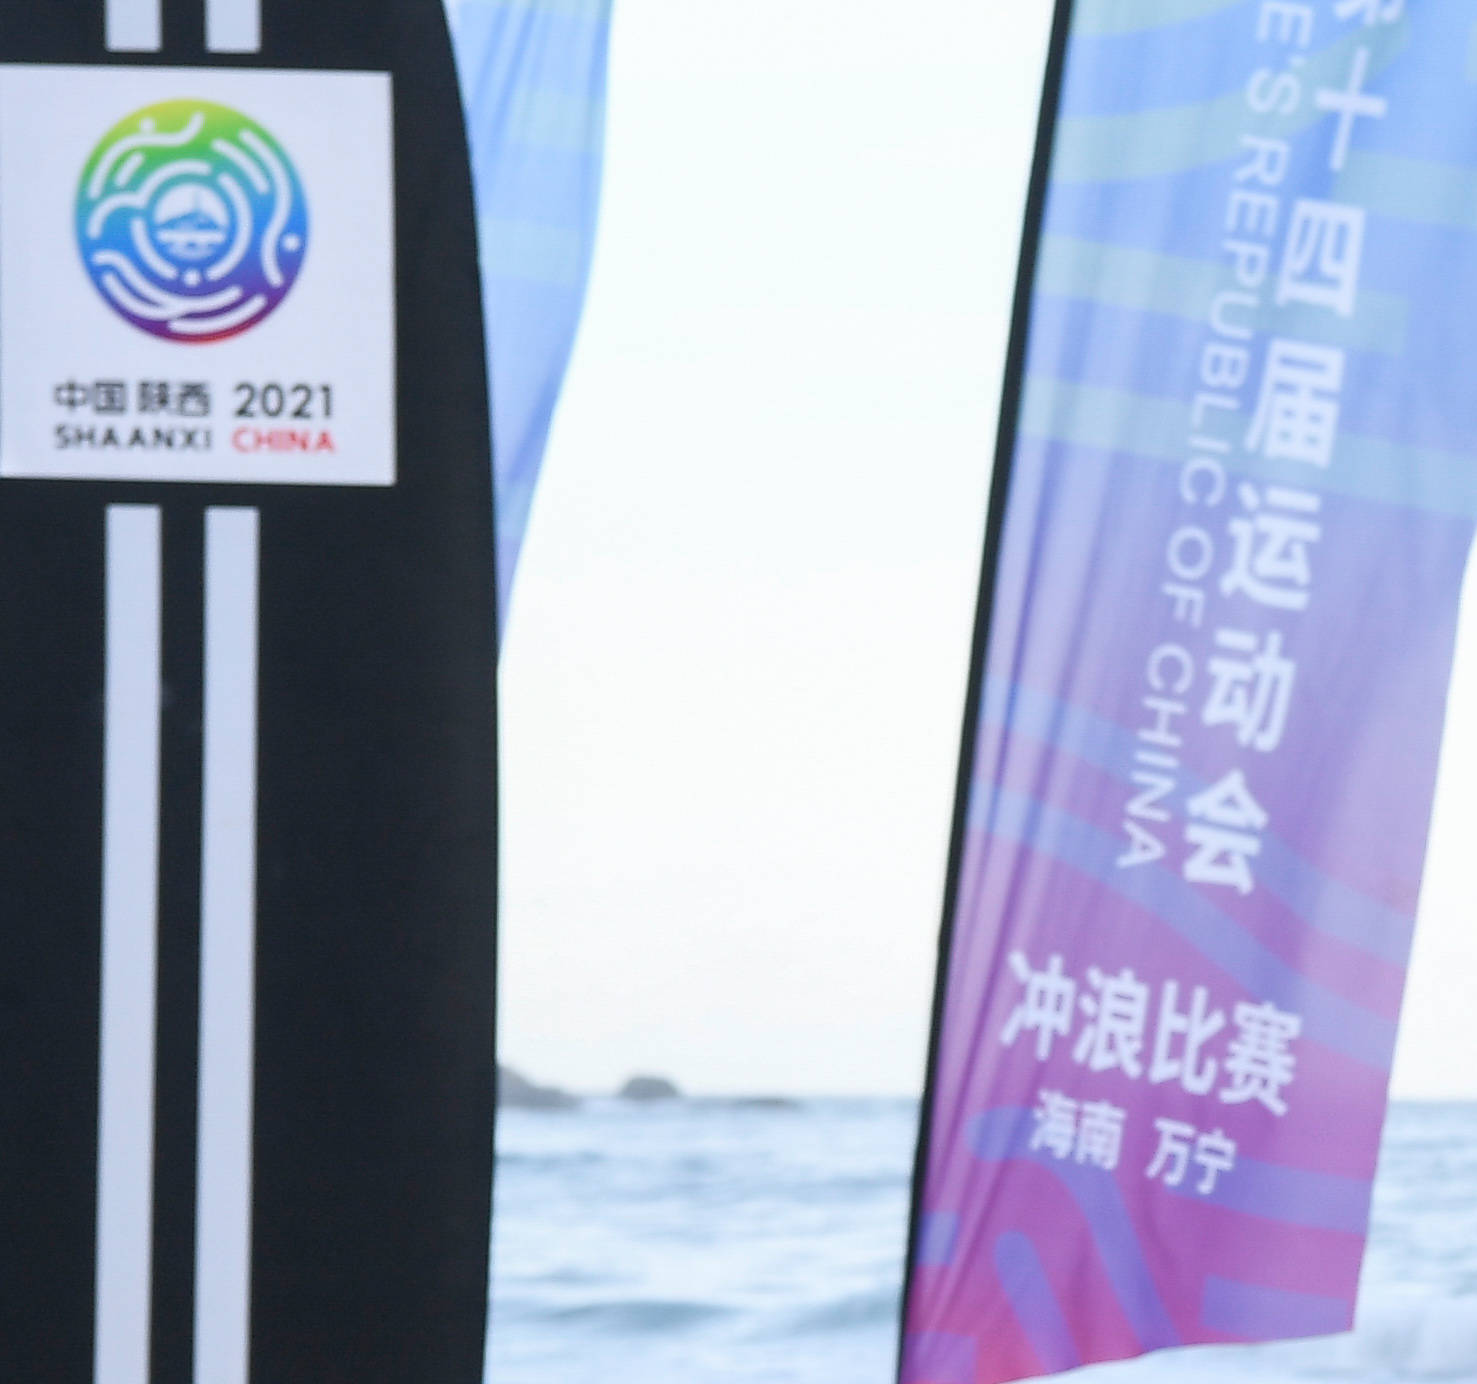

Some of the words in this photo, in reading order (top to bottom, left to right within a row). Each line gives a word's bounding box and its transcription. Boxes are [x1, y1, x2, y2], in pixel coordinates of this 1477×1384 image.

[1178, 131, 1292, 508] REPUBLIC
[54, 379, 129, 416] 中国
[235, 381, 333, 419] 2021
[54, 424, 213, 451] SHAANXI
[232, 426, 337, 454] CHINA
[1162, 524, 1214, 628] OF
[1114, 642, 1196, 871] CHINA
[1001, 949, 1304, 1117] 冲浪比赛
[1028, 1087, 1128, 1171] 海南
[1144, 1115, 1238, 1195] 万宁
